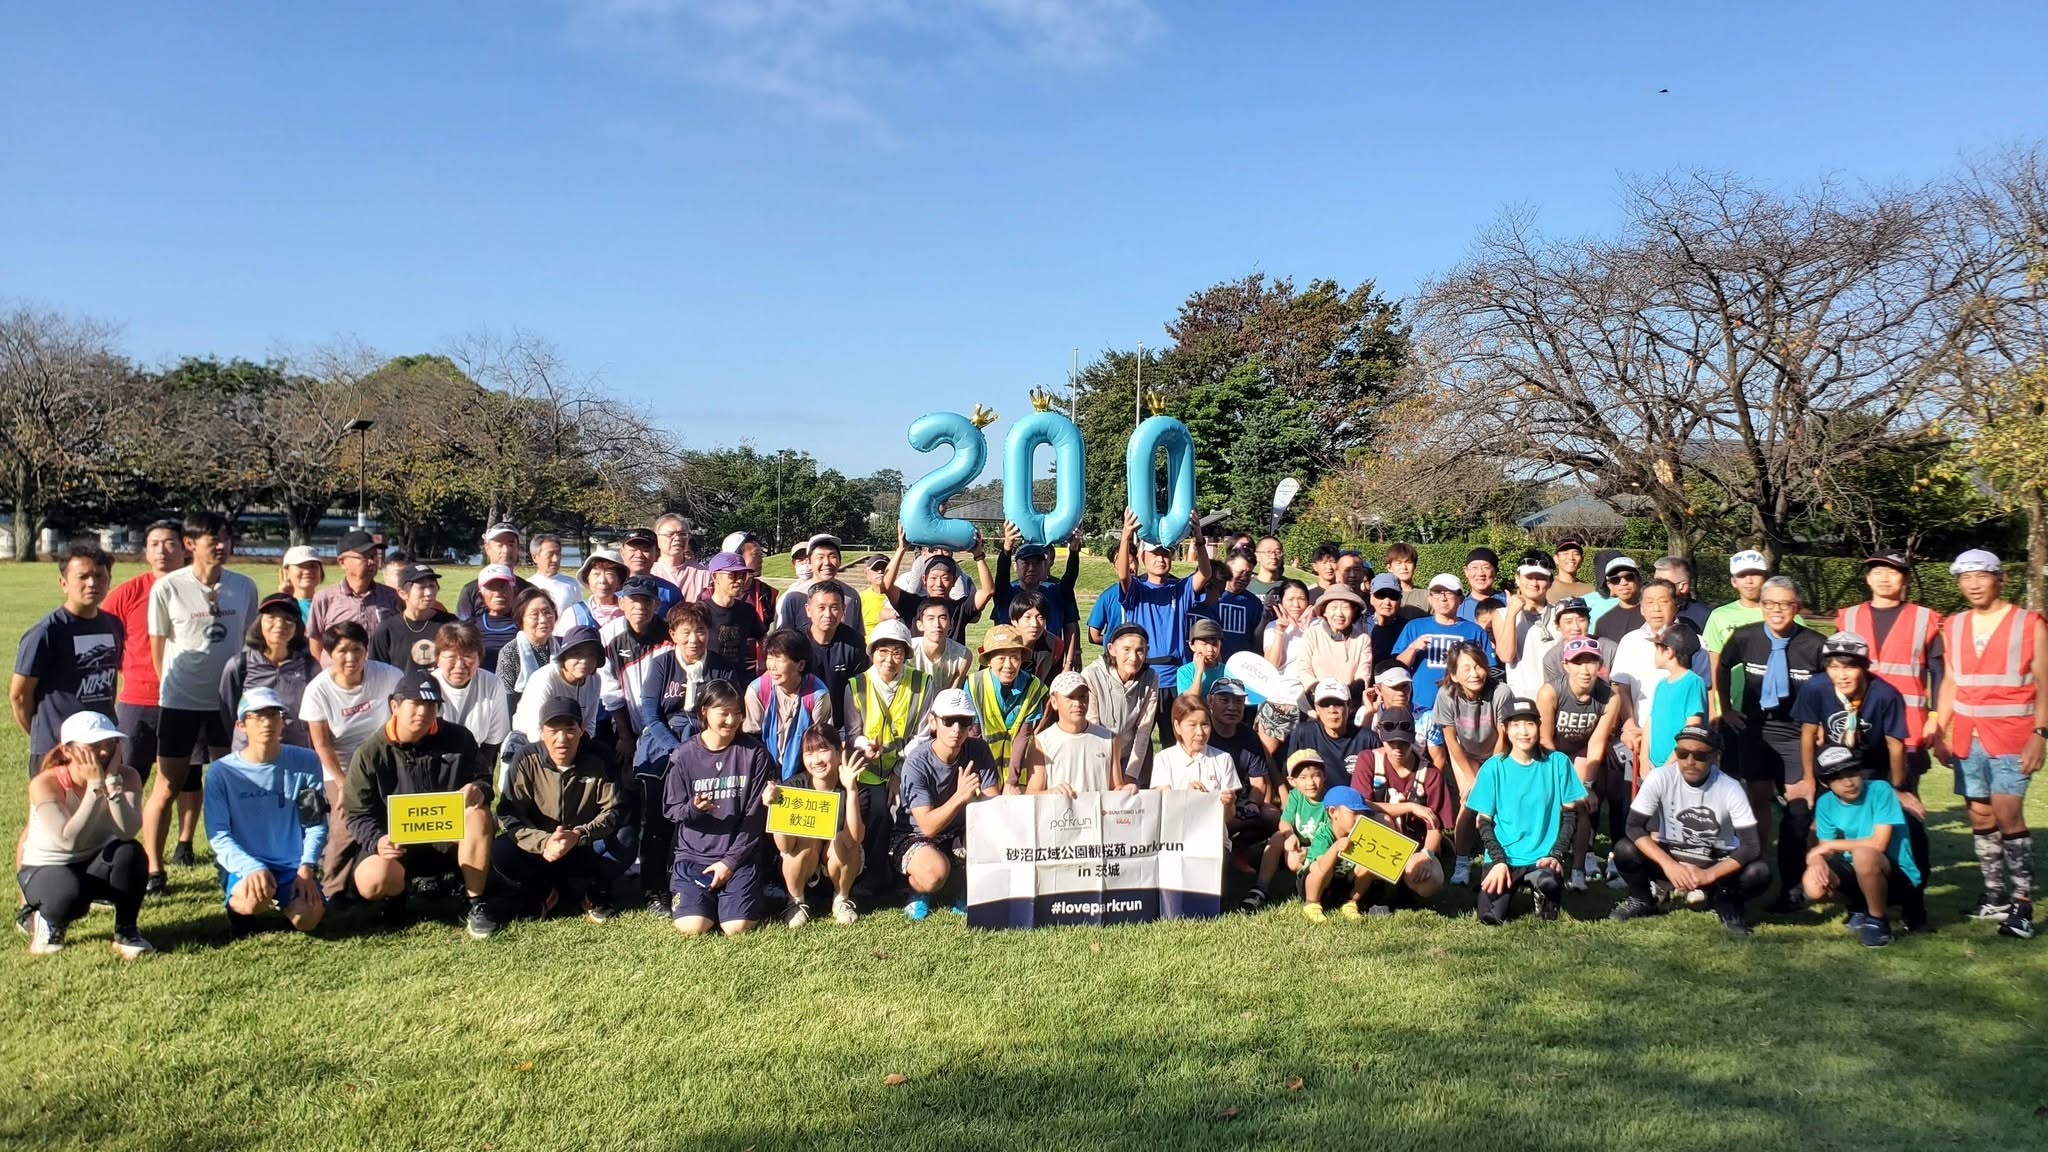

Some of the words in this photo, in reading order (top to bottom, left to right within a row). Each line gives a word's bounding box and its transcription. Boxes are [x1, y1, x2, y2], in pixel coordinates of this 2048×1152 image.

[1557, 710, 1597, 728] BEER
[408, 806, 447, 817] FIRST
[401, 820, 453, 832] TIMERS
[789, 813, 816, 828] 歓迎
[1050, 814, 1092, 830] parkrun
[1006, 843, 1127, 862] 砂沼広域公園観桜苑
[1129, 841, 1184, 857] parkrun
[1352, 834, 1403, 867] ようこそ
[1078, 865, 1091, 877] in
[1095, 863, 1121, 878] 茨城
[1051, 899, 1143, 916] #loveparkrun
